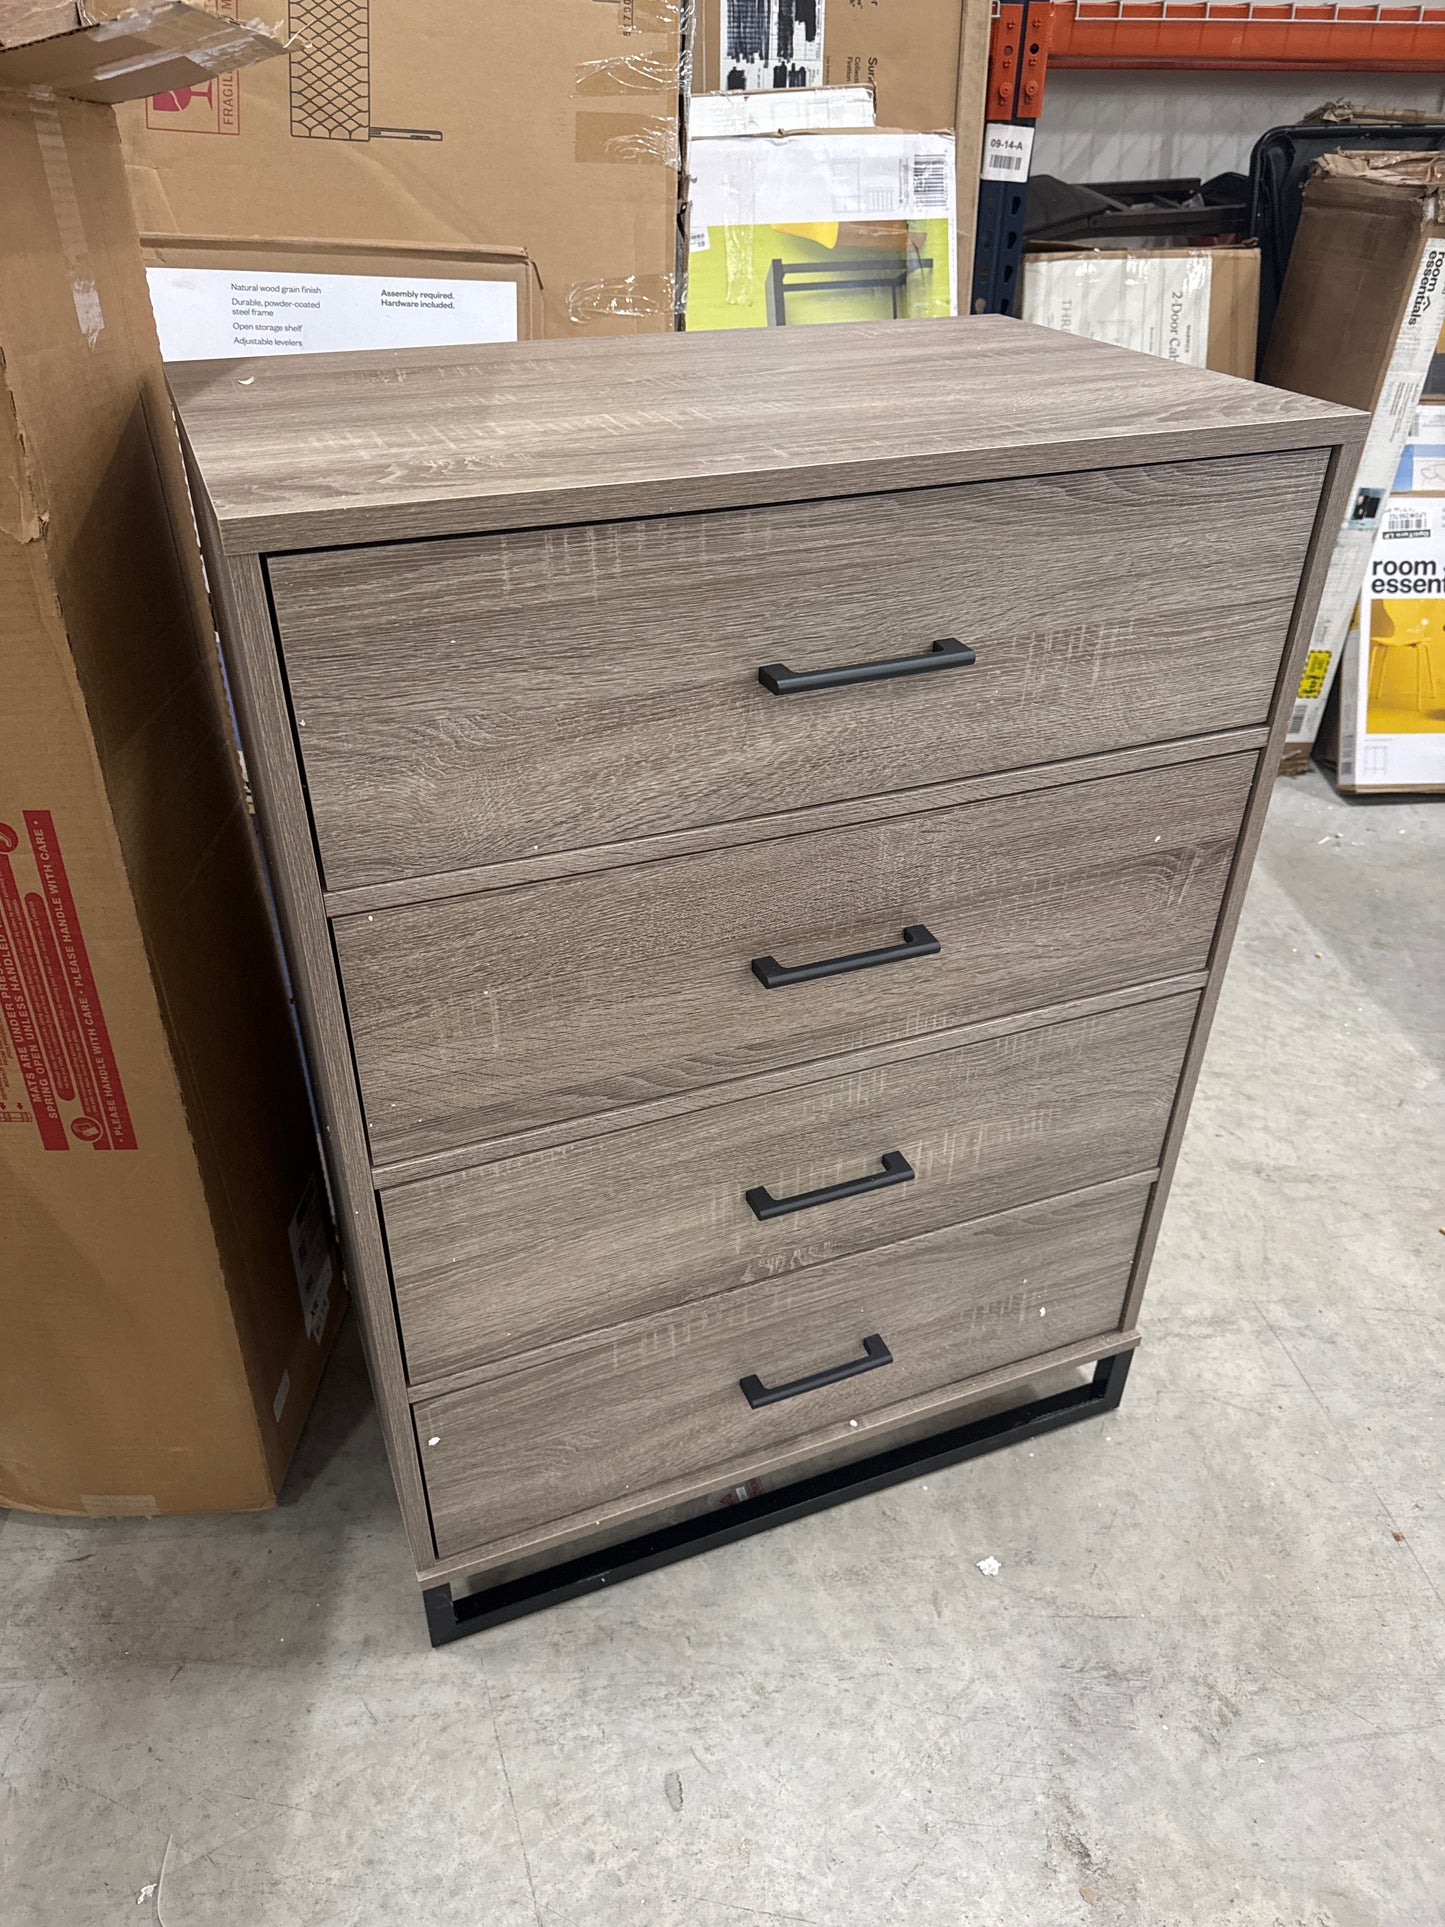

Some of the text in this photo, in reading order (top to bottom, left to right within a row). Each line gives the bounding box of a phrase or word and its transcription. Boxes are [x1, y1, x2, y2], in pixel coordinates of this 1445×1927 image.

[990, 138, 1023, 150] 09-14-A
[1427, 251, 1445, 292] room
[231, 283, 258, 292] Natural
[281, 286, 300, 294] grain
[301, 286, 321, 294] finish
[232, 298, 320, 309] Durable, powder-coated
[381, 289, 455, 300] Assembly required.
[381, 299, 455, 309] Hardware included.
[1408, 251, 1437, 326] essentials
[232, 308, 274, 316] steel frame
[233, 322, 303, 333] Open storage shelf
[1169, 290, 1183, 334] 2-Door
[233, 337, 303, 347] Adjustable levelers
[1372, 560, 1437, 576] room
[33, 828, 50, 861] CARE
[44, 863, 59, 895] WITH
[52, 896, 73, 943] HANDLE
[65, 945, 83, 988] PLEASE
[5, 1003, 24, 1043] UNDER
[14, 995, 35, 1041] UNLESS
[79, 997, 95, 1025] CARE
[18, 1046, 31, 1069] ARE
[87, 1028, 101, 1056] WITH
[30, 1044, 46, 1075] OPEN
[25, 1072, 42, 1103] MATS
[95, 1057, 113, 1097] HANDLE
[38, 1080, 58, 1119] SPRING
[107, 1099, 123, 1136] PLEASE
